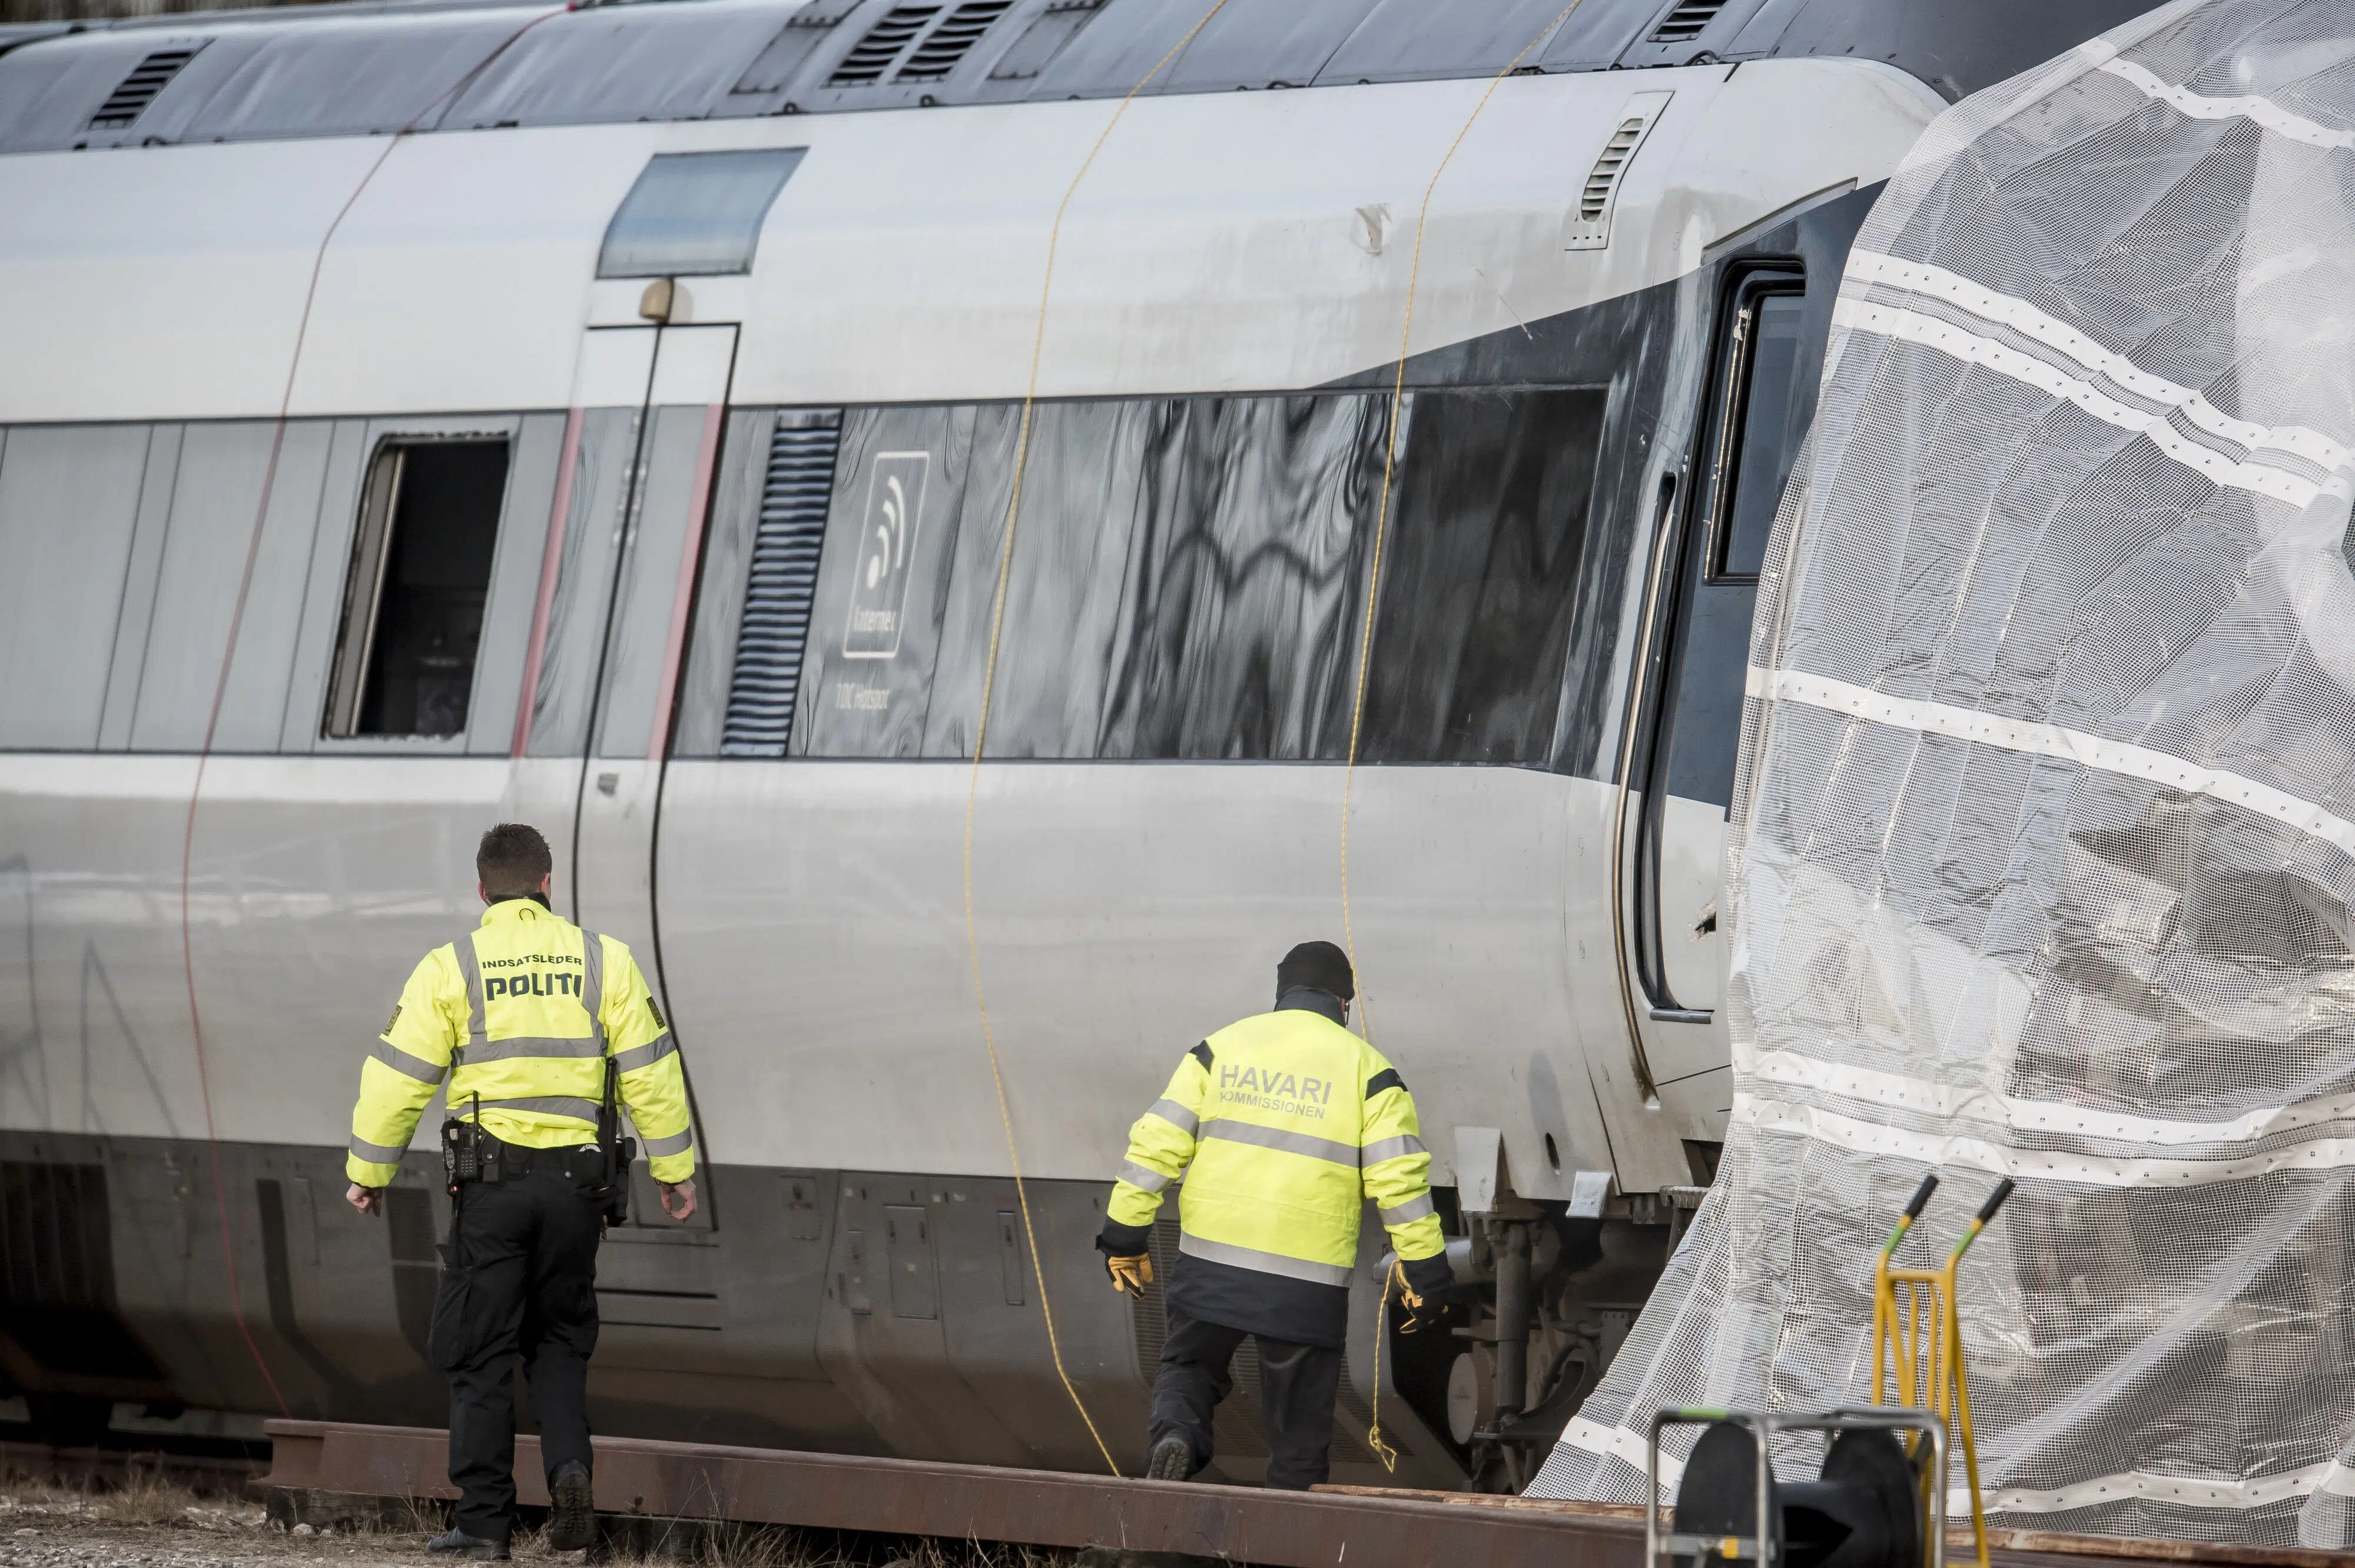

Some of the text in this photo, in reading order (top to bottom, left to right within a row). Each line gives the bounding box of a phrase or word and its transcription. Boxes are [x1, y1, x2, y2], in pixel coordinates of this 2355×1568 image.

[482, 954, 582, 969] INDSATSLEDER
[485, 972, 582, 1001] POLITI
[1220, 1064, 1332, 1105] HAVARI
[1220, 1091, 1326, 1119] KOMMISSIONEN
